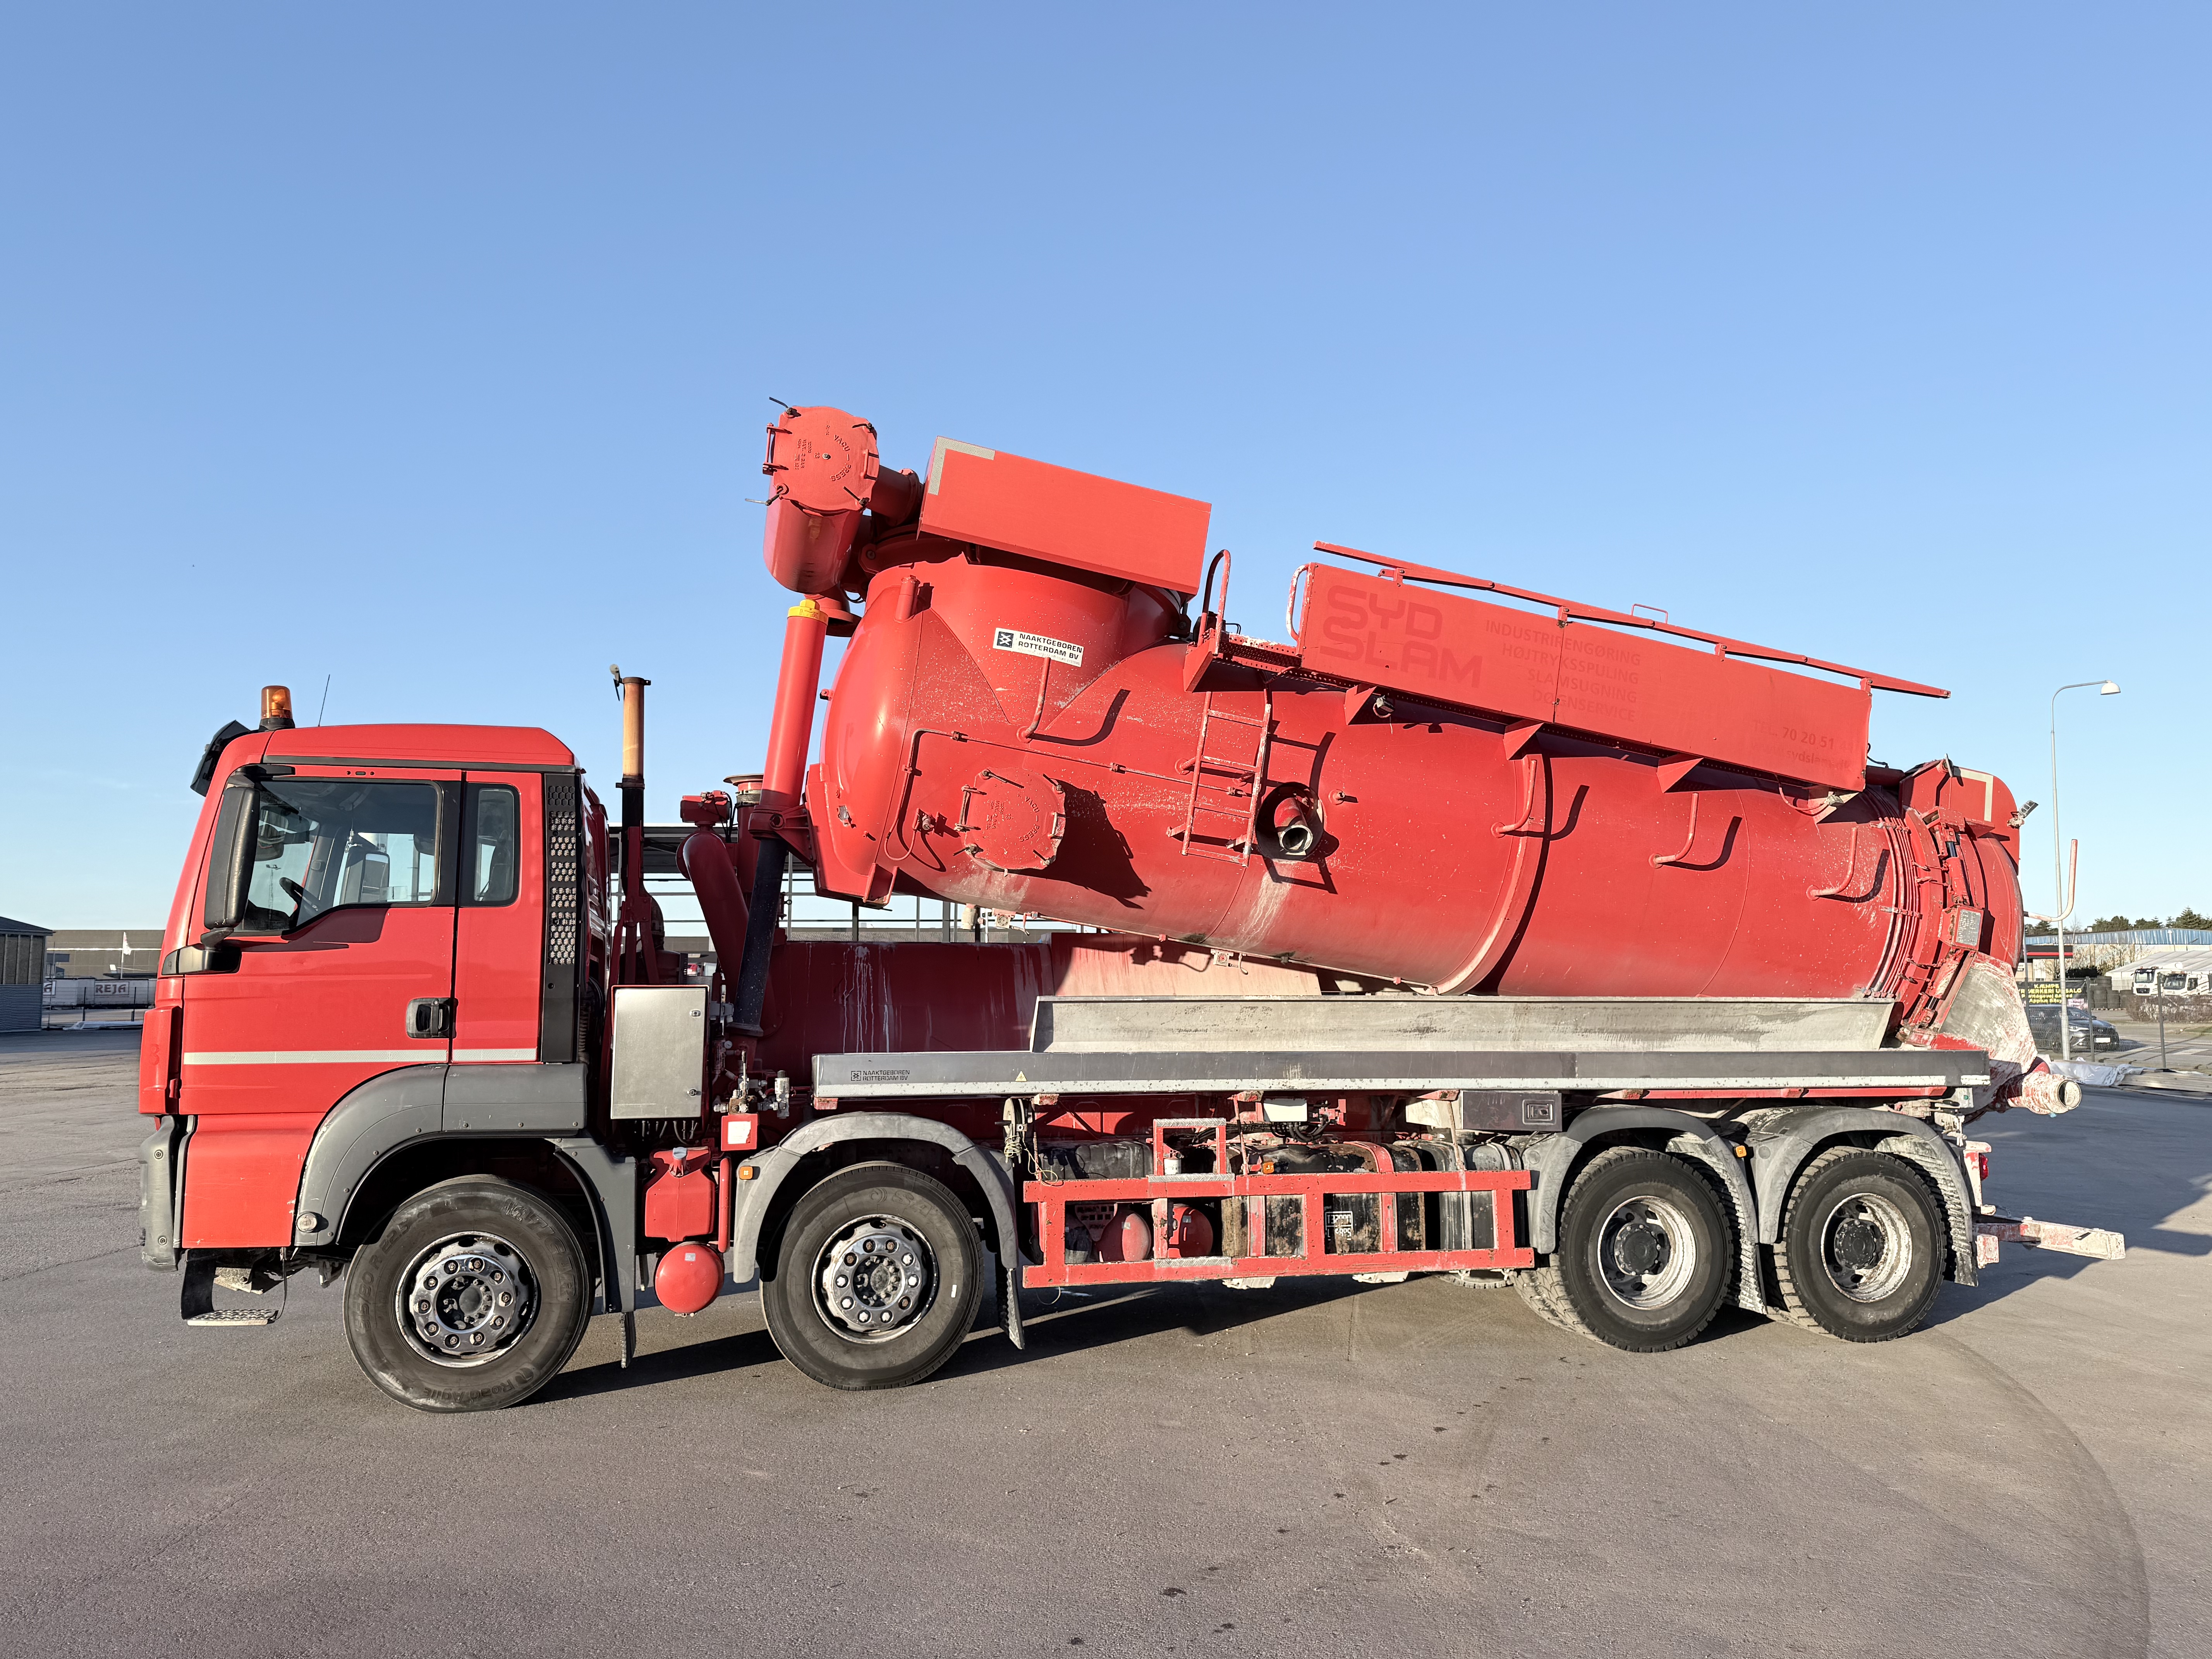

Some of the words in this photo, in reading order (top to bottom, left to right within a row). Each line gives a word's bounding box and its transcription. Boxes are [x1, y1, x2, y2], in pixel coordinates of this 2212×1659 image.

[1328, 585, 1443, 640] SYD
[1018, 641, 1066, 657] ROTTERDAM
[1019, 633, 1082, 653] NAAKTGEBOREN
[1320, 616, 1483, 689] SLAM
[1783, 726, 1797, 741] 70
[1801, 732, 1816, 745] 20
[1820, 736, 1834, 750] 51
[95, 984, 126, 994] REJA
